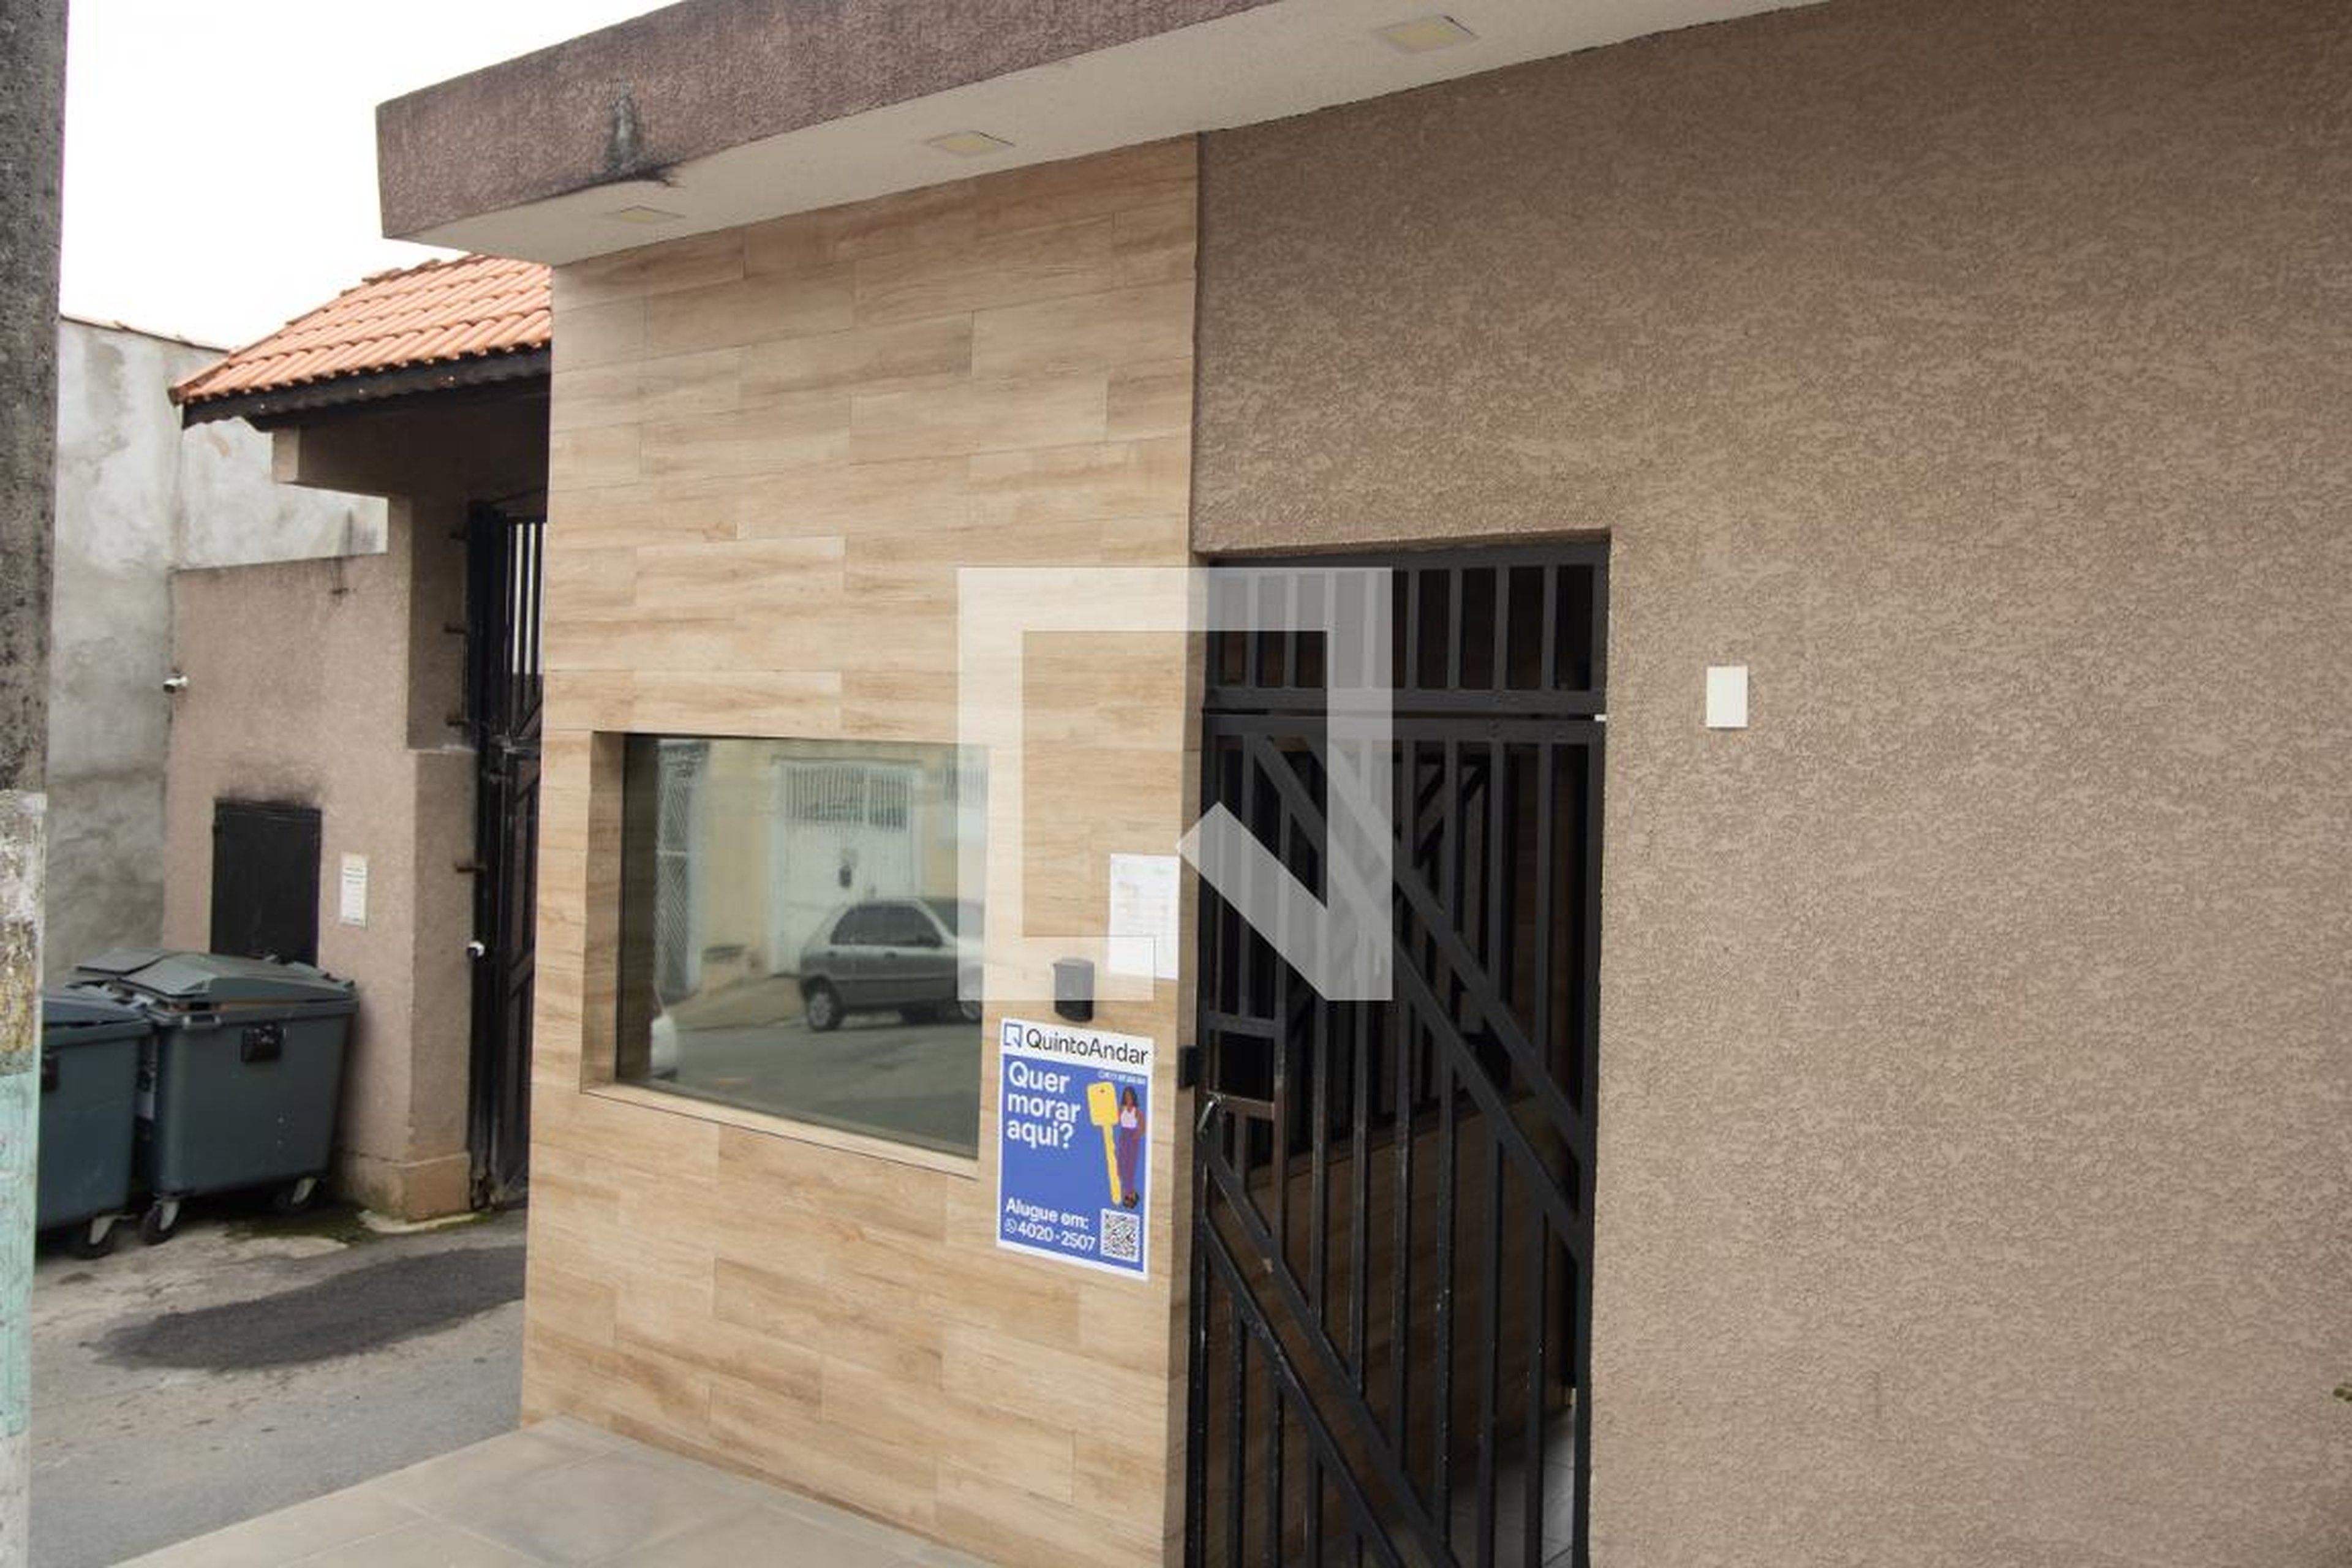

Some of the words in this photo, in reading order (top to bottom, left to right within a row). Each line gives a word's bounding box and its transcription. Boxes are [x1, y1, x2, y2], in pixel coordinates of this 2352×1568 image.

[1025, 1028, 1149, 1066] QuintoAndar
[1008, 1061, 1071, 1094] Quer
[1008, 1091, 1080, 1124] morar
[1006, 1121, 1074, 1150] aqui?
[1006, 1197, 1058, 1224] Alugue
[1061, 1212, 1089, 1230] em:
